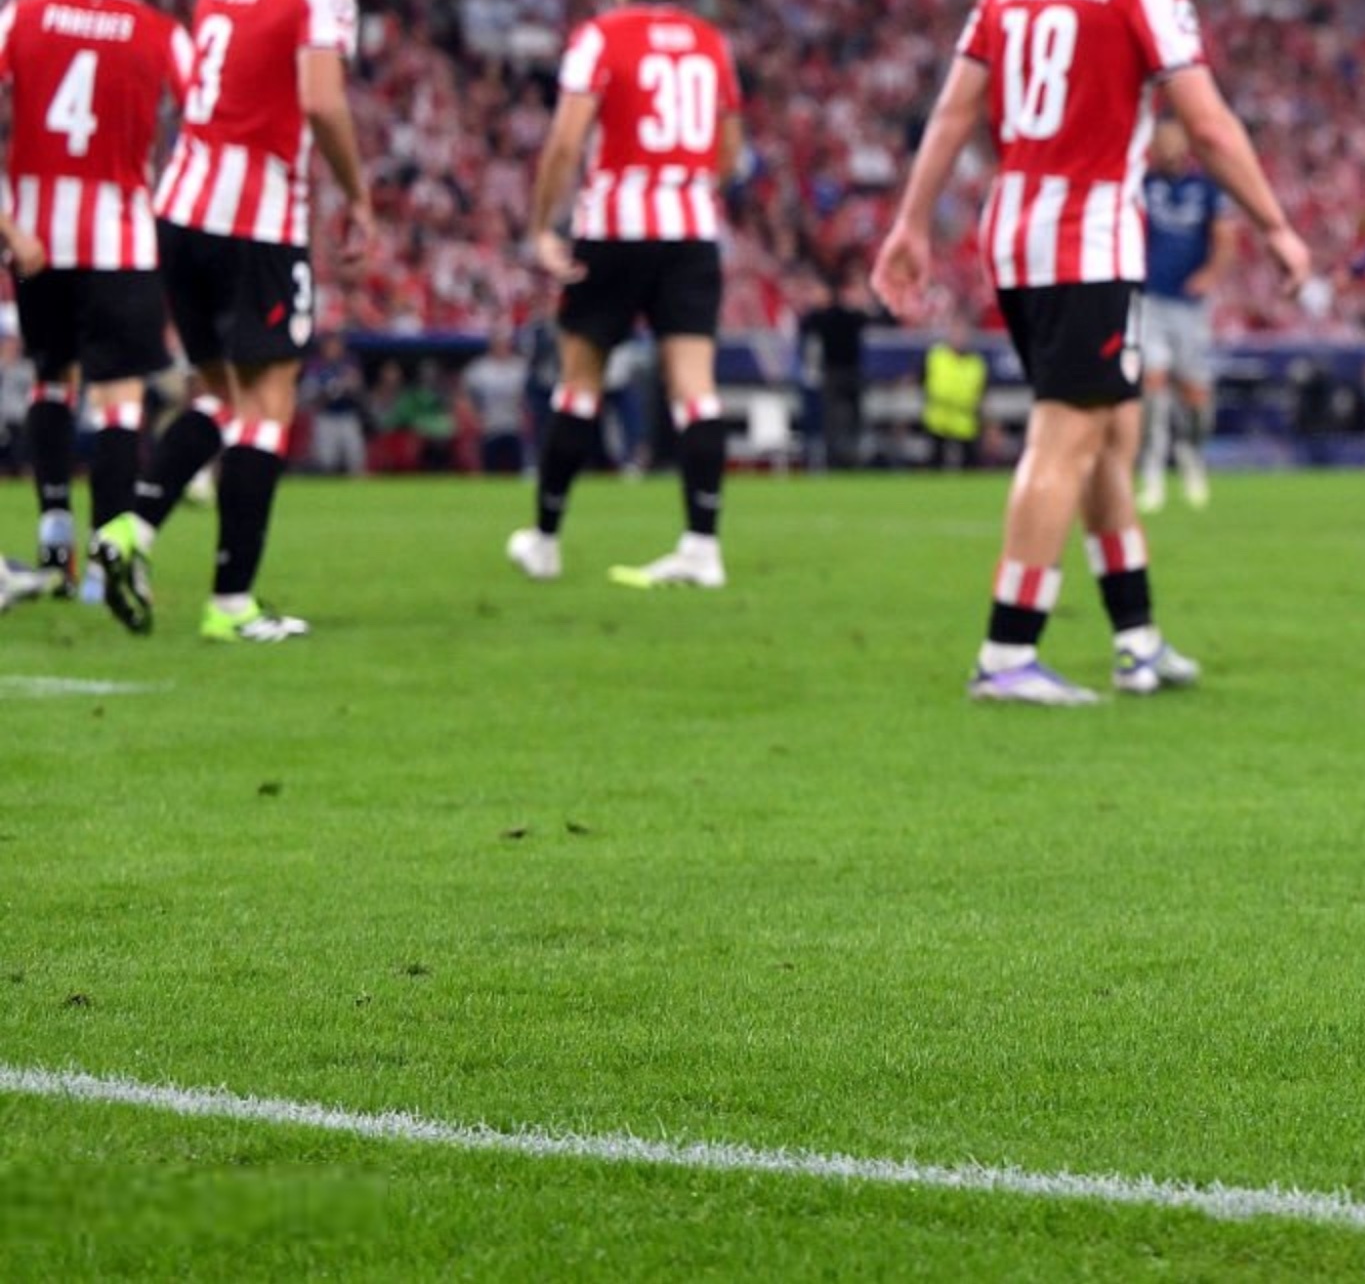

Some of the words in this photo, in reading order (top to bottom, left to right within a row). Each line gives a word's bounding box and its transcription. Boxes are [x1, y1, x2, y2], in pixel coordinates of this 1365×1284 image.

[45, 49, 98, 158] 4
[184, 13, 234, 126] 3
[637, 52, 718, 154] 30
[1000, 3, 1079, 144] 18
